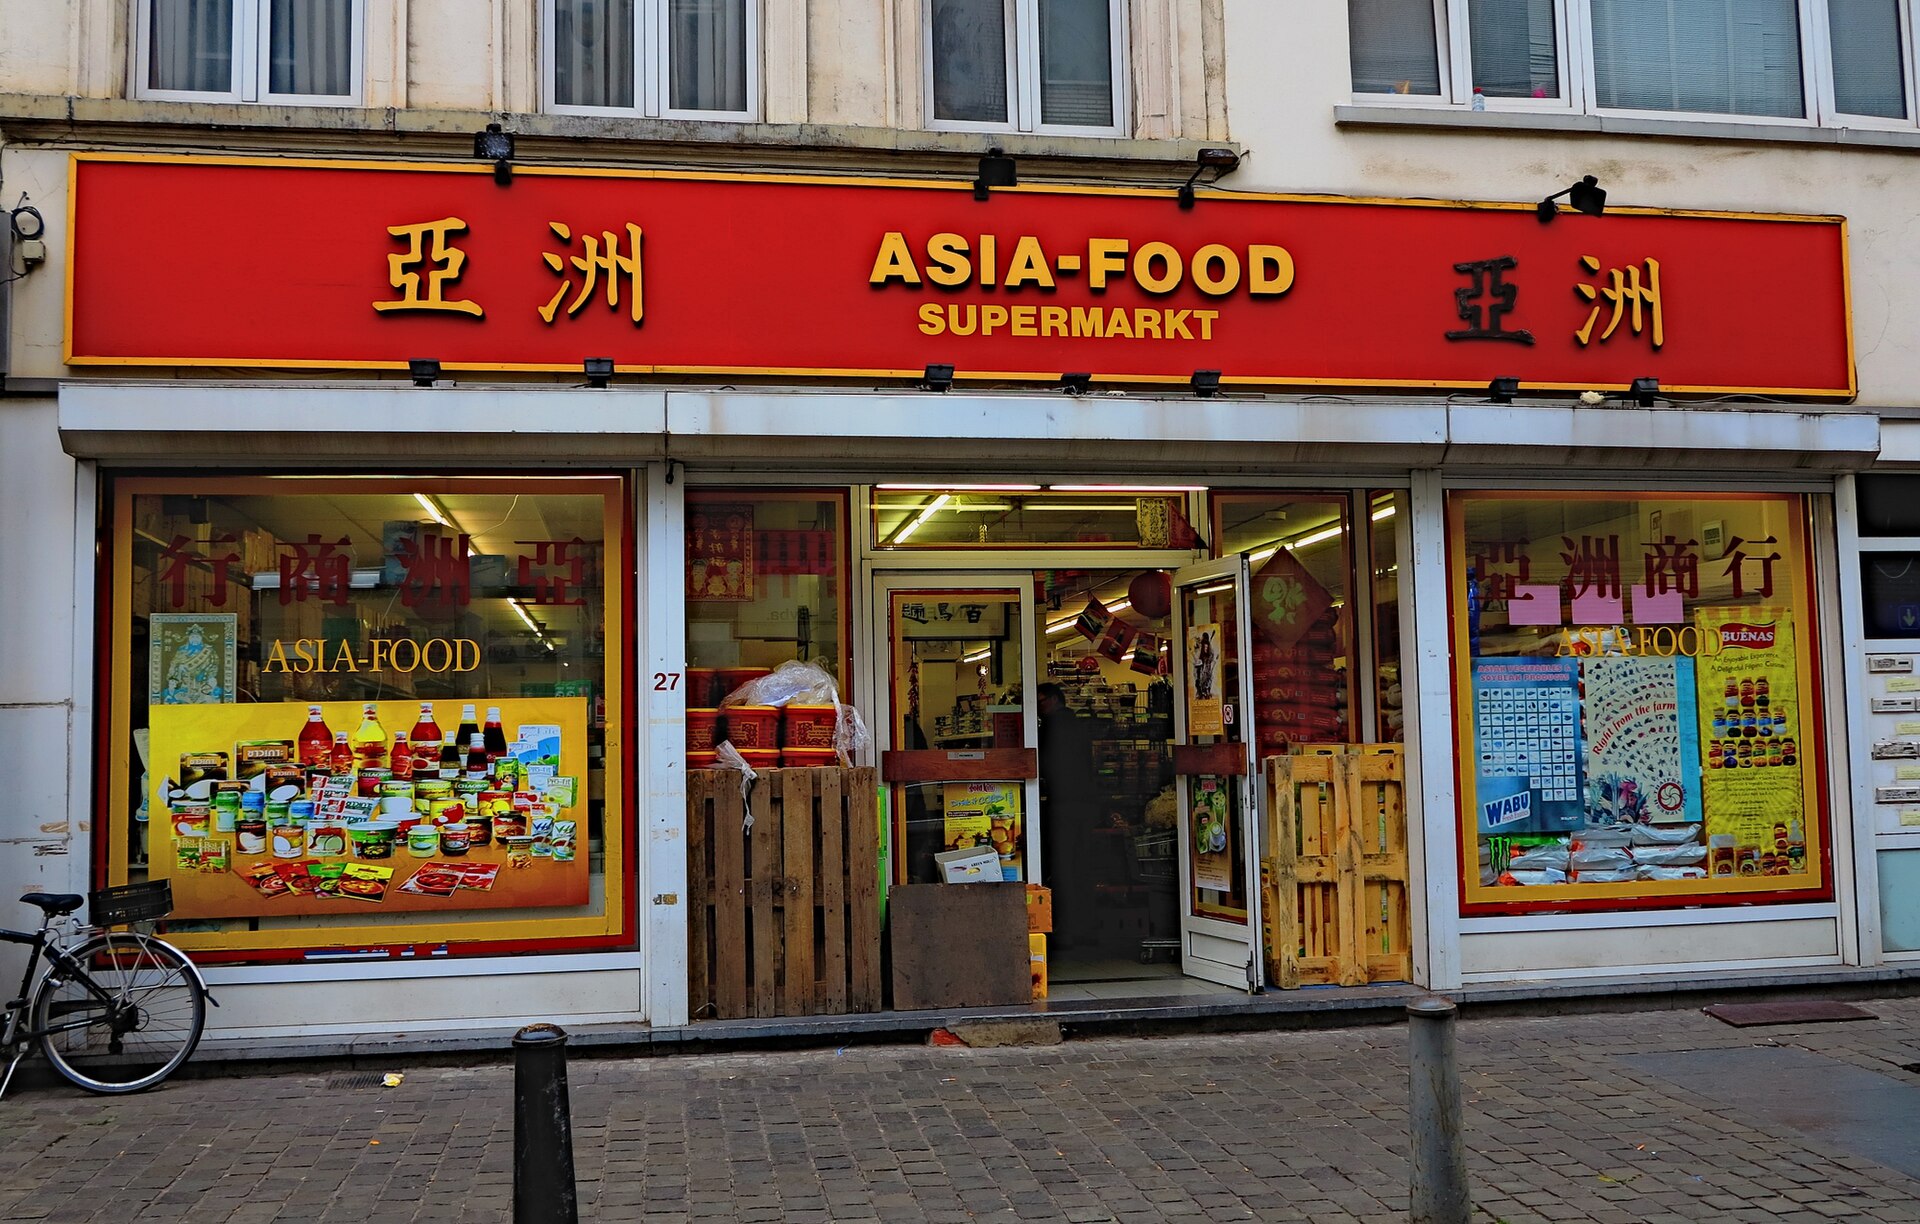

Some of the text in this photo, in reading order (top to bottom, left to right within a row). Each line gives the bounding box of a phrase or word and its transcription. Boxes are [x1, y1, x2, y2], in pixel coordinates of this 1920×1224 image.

[869, 231, 1296, 297] ASIA-FOOD
[917, 303, 1220, 341] SUPERMARKT
[1555, 626, 1724, 657] ASIA-FOOD
[1721, 631, 1774, 643] BUENAS
[262, 637, 481, 674] ASIA-FOOD
[653, 672, 681, 691] 27
[1524, 673, 1570, 682] PRODUCTS
[1592, 700, 1676, 755] Right from the farm
[1485, 792, 1529, 826] WABU
